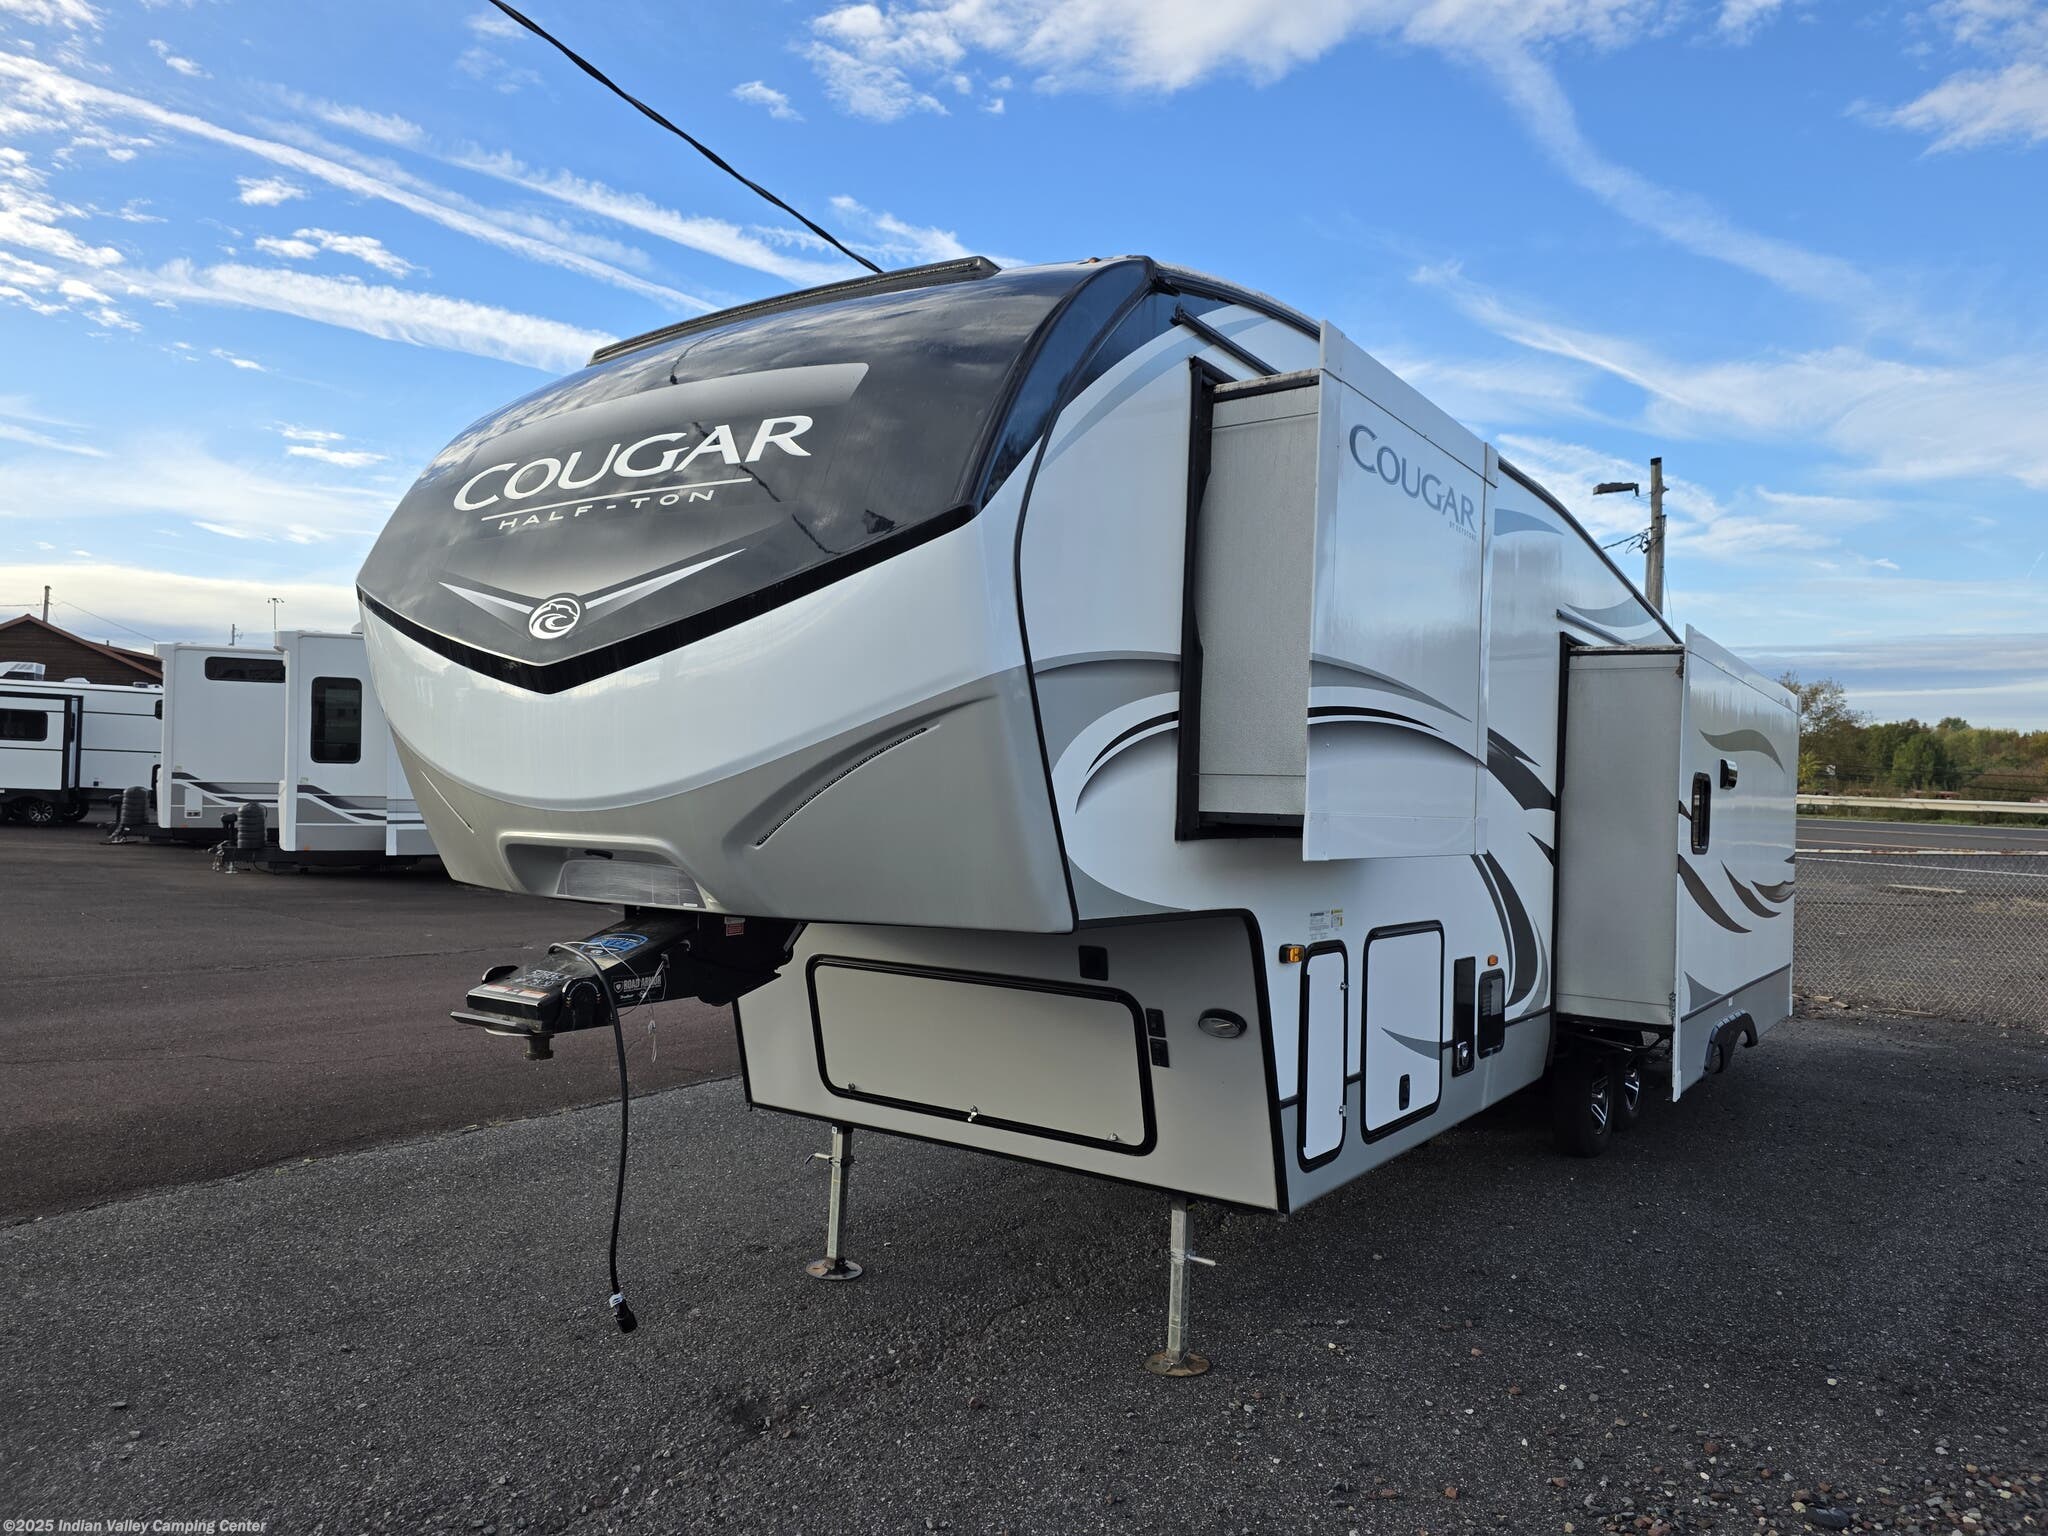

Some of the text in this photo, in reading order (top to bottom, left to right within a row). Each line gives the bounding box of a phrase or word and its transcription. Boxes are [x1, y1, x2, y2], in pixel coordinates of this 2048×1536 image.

[453, 415, 814, 512] COUGAR
[1349, 423, 1477, 534] COUGAR
[498, 489, 716, 530] HALF-TON
[623, 975, 662, 991] ROAD ARMOR
